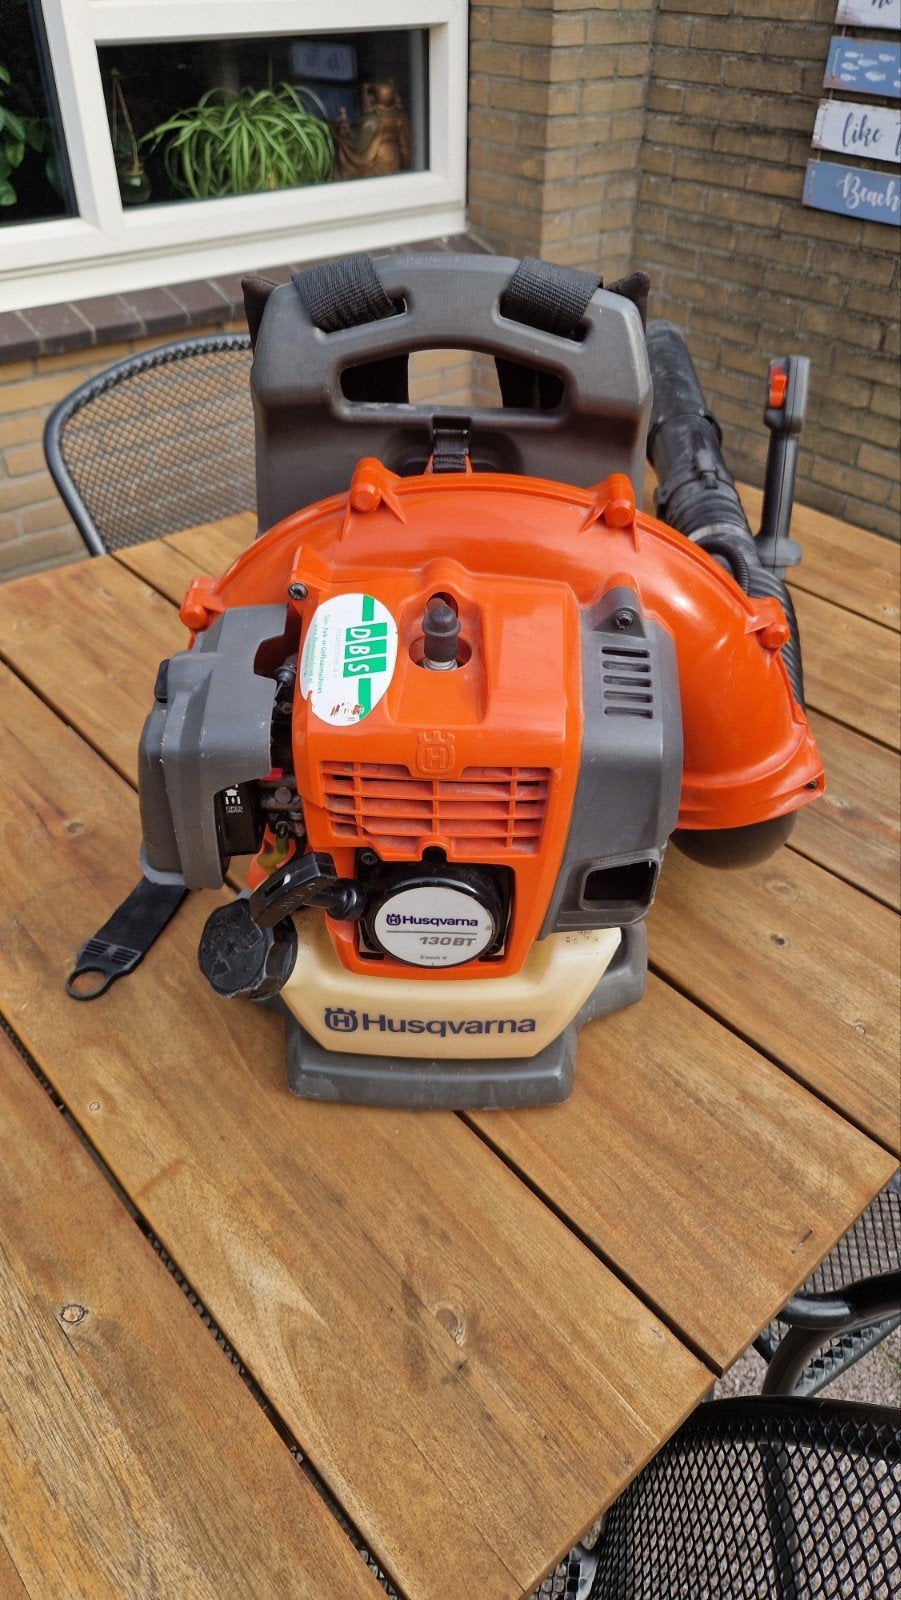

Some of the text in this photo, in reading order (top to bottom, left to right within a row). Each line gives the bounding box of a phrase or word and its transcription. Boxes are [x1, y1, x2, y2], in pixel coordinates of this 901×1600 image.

[842, 112, 881, 147] like
[836, 172, 901, 212] Beach
[348, 628, 371, 672] DBS
[402, 915, 479, 927] Husqvarna
[419, 936, 477, 947] 130BT
[362, 1013, 537, 1037] Husqvarna
